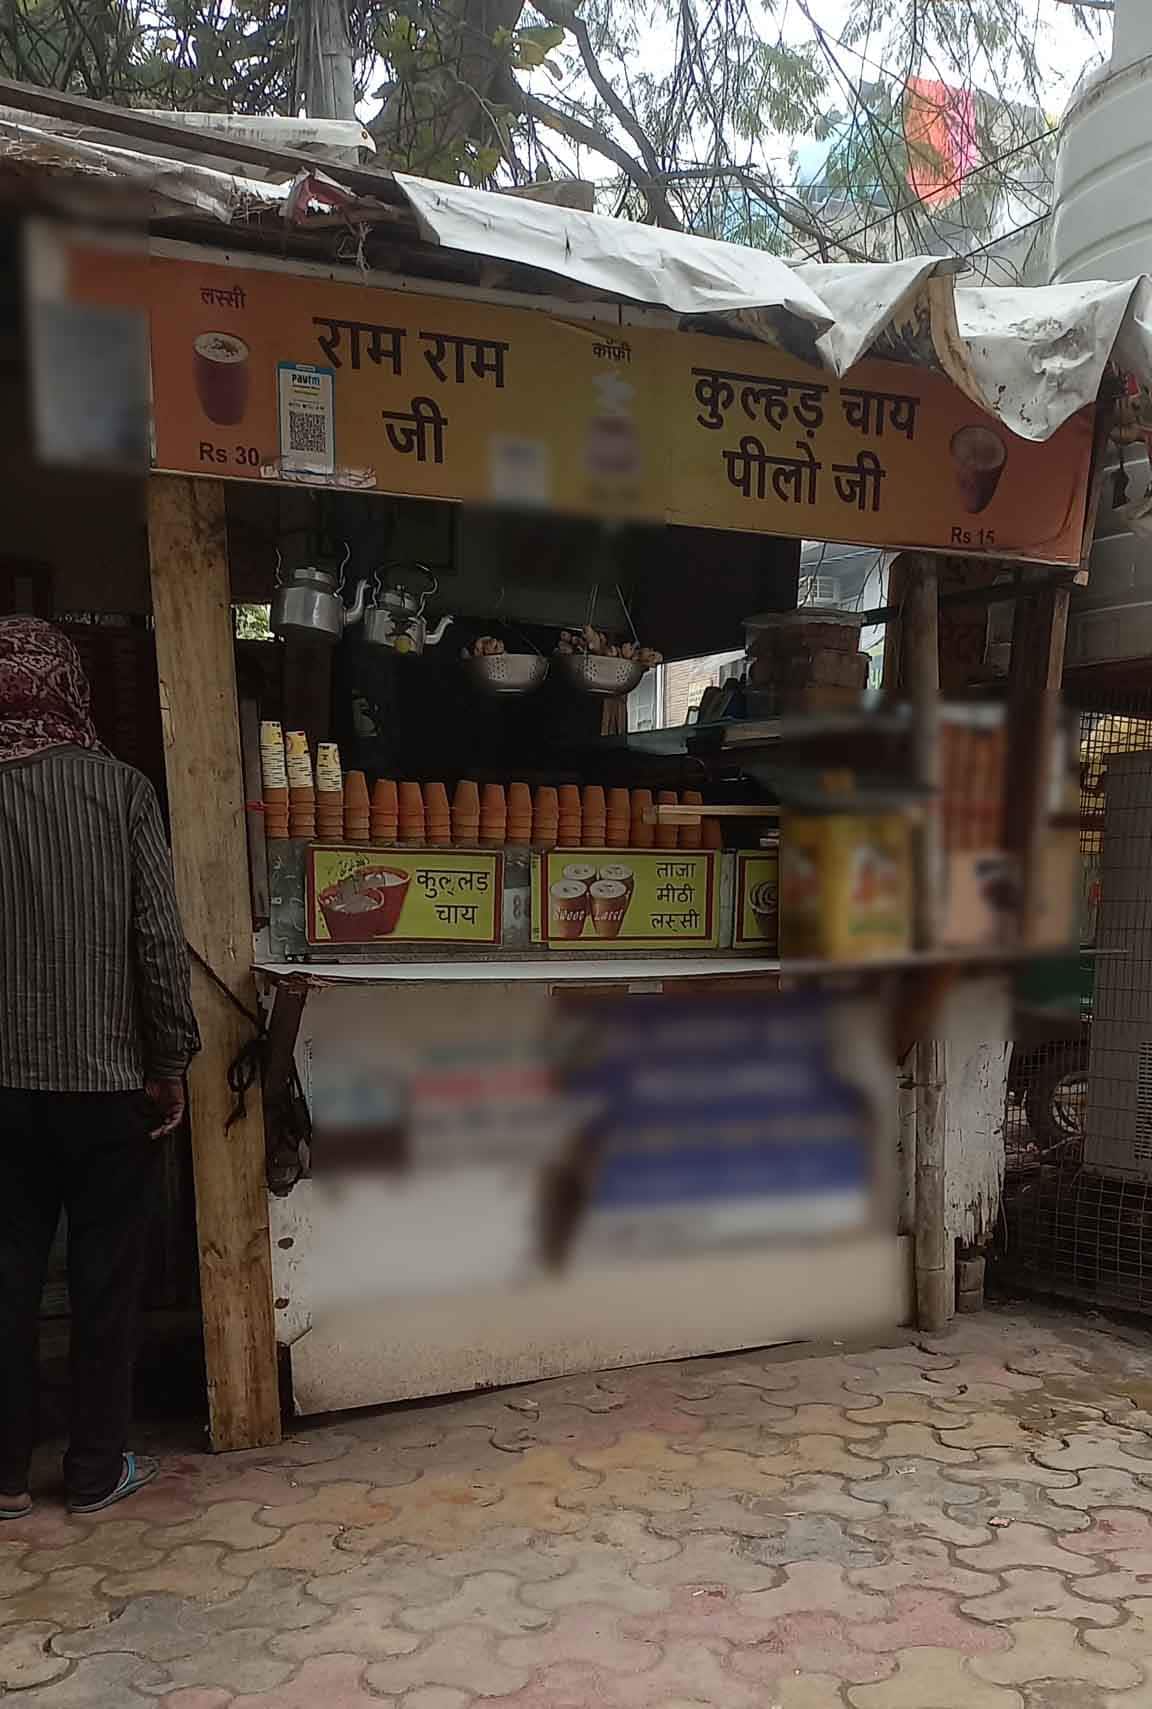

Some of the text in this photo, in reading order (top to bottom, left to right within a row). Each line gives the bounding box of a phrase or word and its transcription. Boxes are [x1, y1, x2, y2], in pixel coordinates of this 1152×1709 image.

[200, 285, 247, 310] लस्सी
[312, 316, 510, 388] राम राम
[691, 367, 920, 440] कुल्हड़ चाय
[382, 396, 448, 464] जी
[199, 442, 260, 466] Rs 30
[722, 435, 887, 512] पीलो जी
[951, 526, 996, 545] Rs 15
[656, 883, 696, 903] मीठी
[434, 905, 479, 925] चाय
[650, 908, 701, 933] लस्सी
